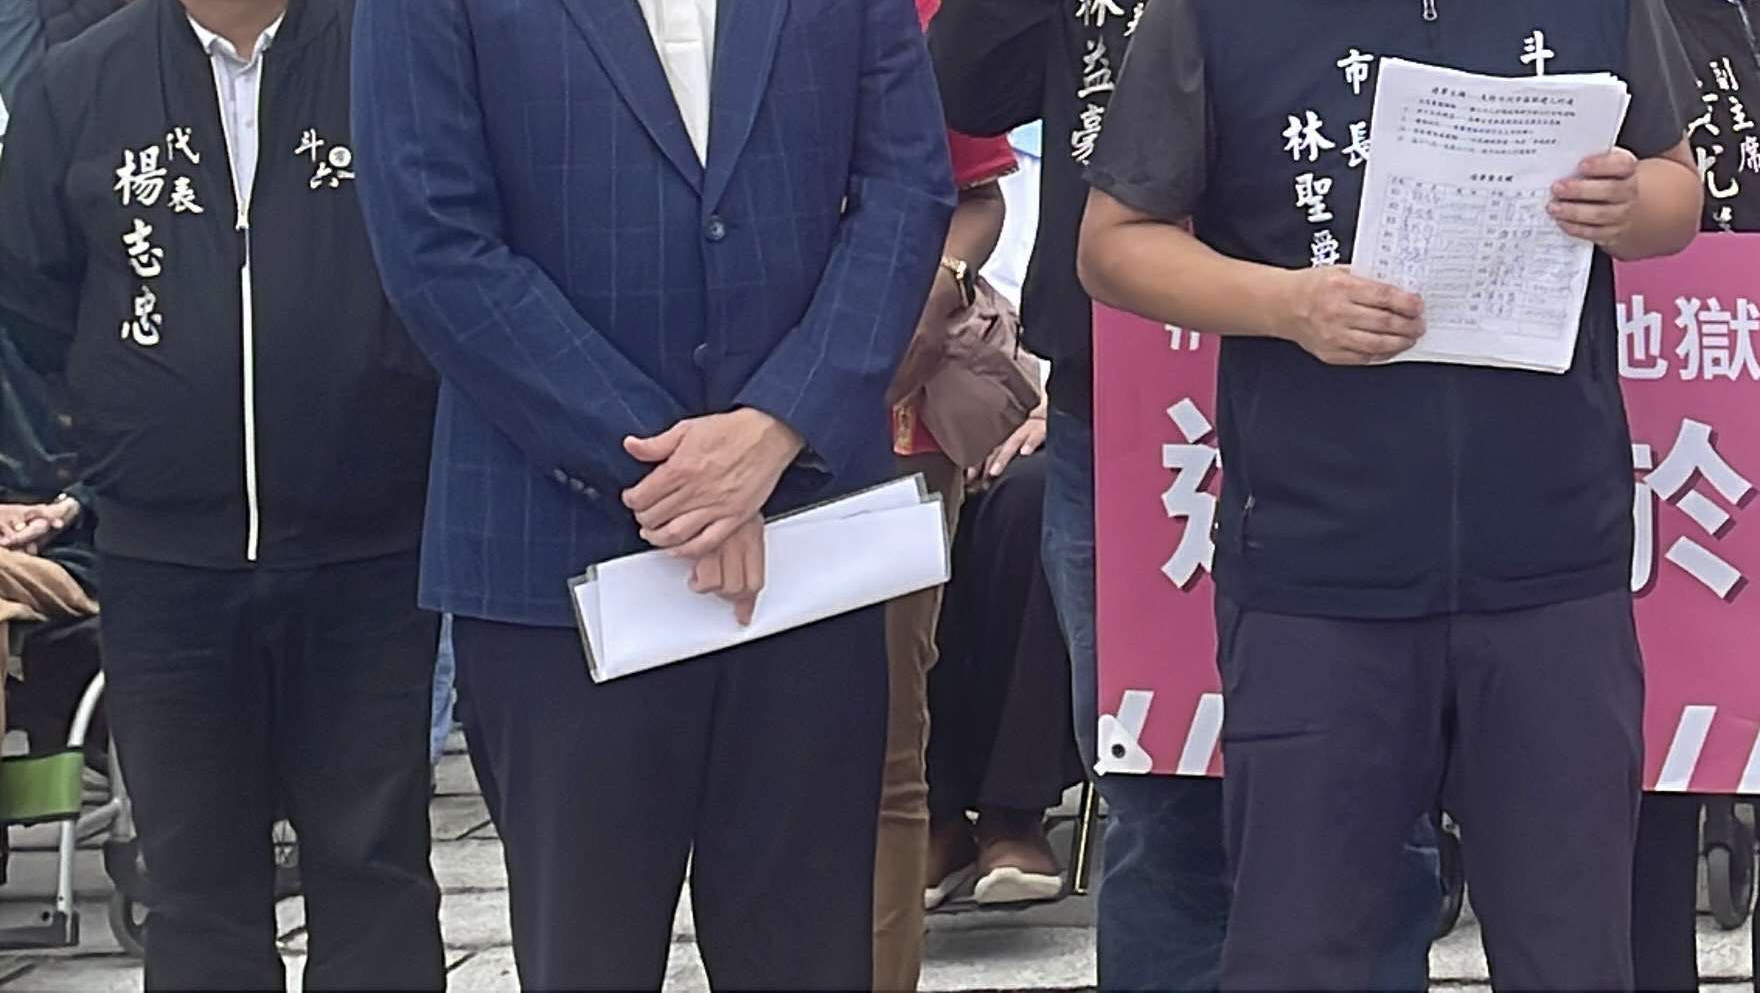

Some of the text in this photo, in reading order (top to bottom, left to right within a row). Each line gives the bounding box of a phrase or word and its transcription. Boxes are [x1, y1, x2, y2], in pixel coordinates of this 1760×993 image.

[165, 127, 204, 214] 代表
[113, 145, 168, 347] 楊志忠
